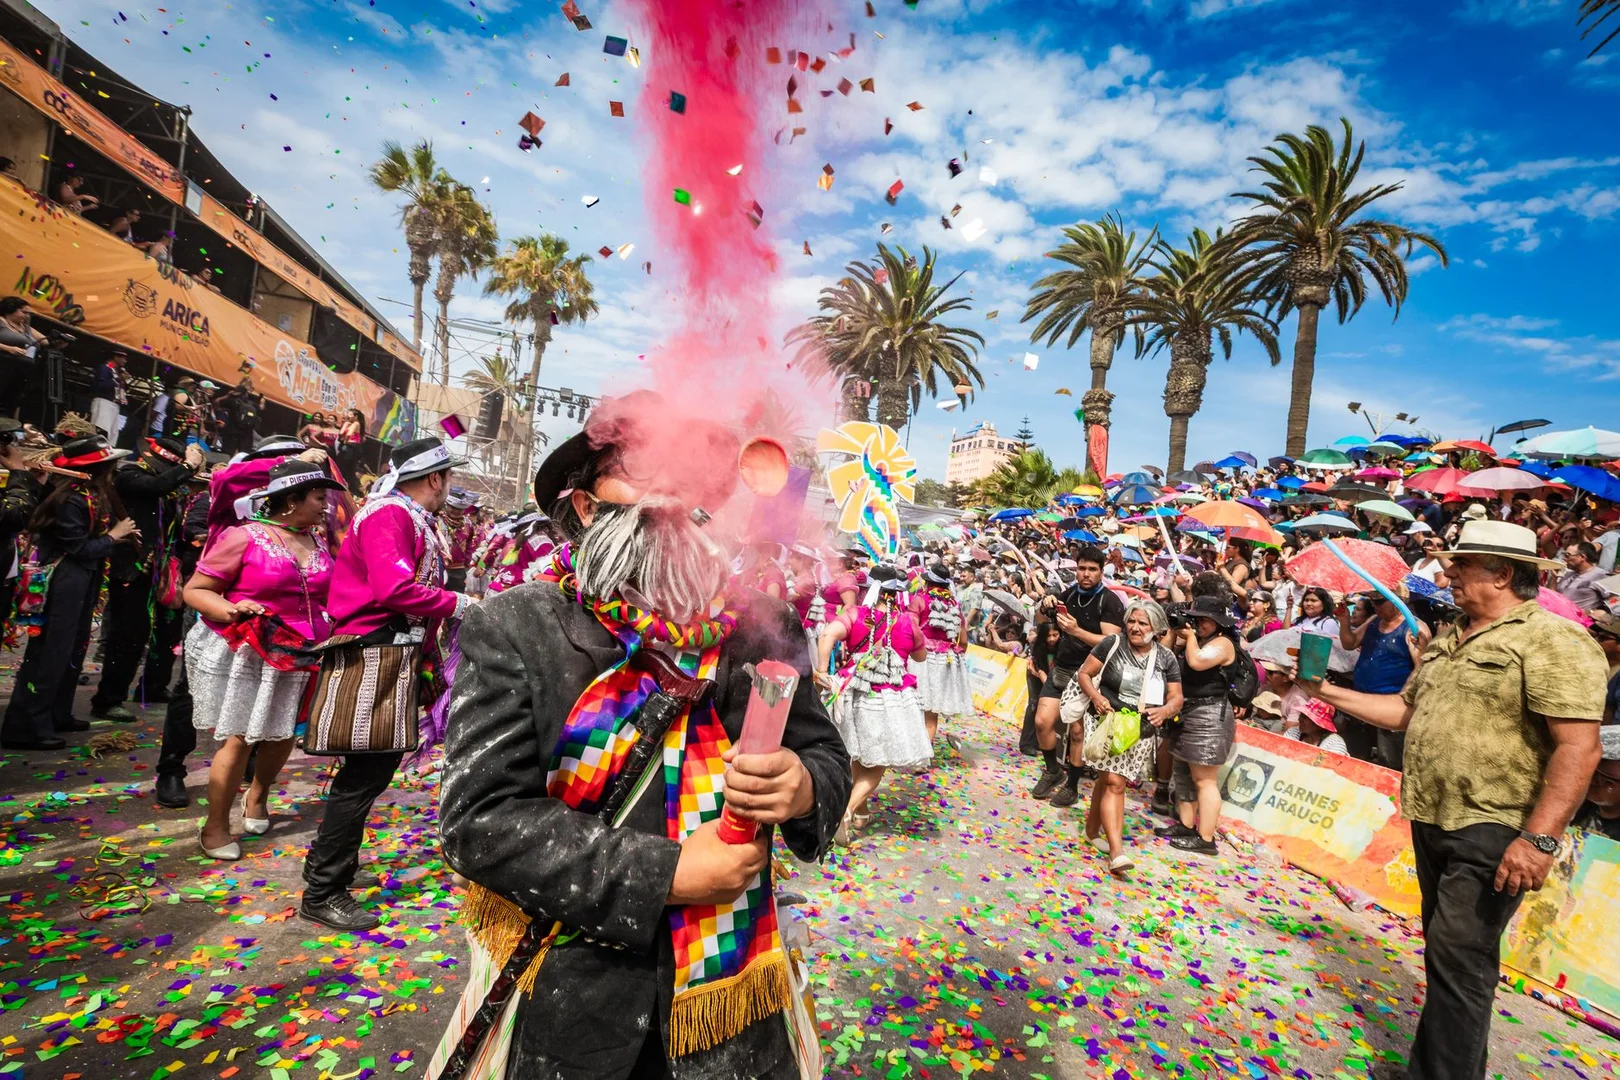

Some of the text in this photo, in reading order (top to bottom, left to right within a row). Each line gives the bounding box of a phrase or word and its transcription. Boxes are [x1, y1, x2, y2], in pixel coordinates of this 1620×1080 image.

[162, 298, 210, 337] ARICA
[290, 473, 314, 486] PUEBLO
[1264, 794, 1334, 830] ARAUCO
[1273, 779, 1341, 814] CARNES
